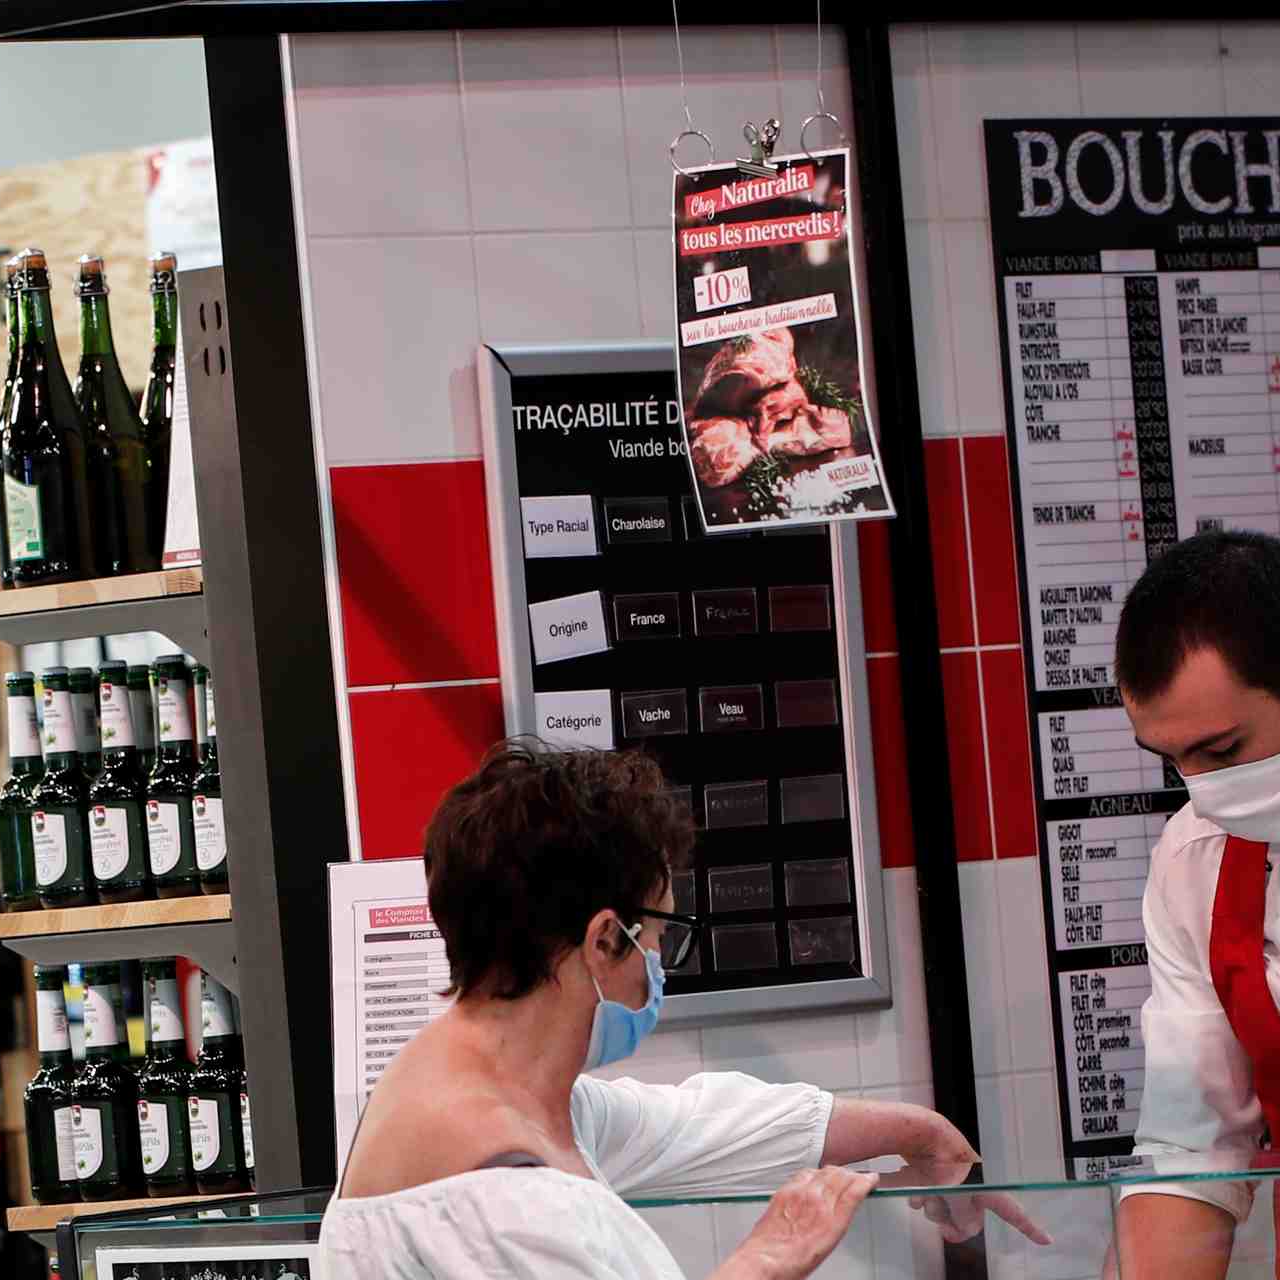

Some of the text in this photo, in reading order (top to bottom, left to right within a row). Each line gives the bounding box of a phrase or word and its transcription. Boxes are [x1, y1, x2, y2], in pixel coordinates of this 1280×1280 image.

[690, 167, 809, 220] Chez Naturalia
[682, 231, 717, 250] tous
[721, 223, 742, 245] les
[1177, 222, 1204, 243] prix
[1208, 224, 1224, 237] au
[1006, 254, 1099, 272] VIANDE BOVINE
[512, 394, 660, 435] TRAÇABILITÉ
[609, 438, 664, 458] Viande
[528, 519, 589, 536] Type Racial
[612, 516, 665, 531] Charolaise
[630, 612, 665, 626] France
[549, 619, 588, 638] Origine
[1091, 687, 1121, 705] VEA
[639, 708, 671, 722] Vache
[719, 702, 744, 716] Veau
[546, 714, 601, 730] Catégorie
[1049, 716, 1065, 734] FILET
[1051, 737, 1069, 753] NOIX
[1089, 794, 1152, 817] AGNEAU
[1058, 824, 1081, 841] GIGOT
[1059, 844, 1082, 862] GIGOT
[1061, 865, 1079, 882] SELLE
[1063, 886, 1079, 903] FILET
[1064, 905, 1102, 924] FAUX-FILET
[1065, 925, 1102, 943] CÔTE FILET
[1070, 974, 1088, 992] FILET
[1072, 994, 1089, 1011] FILET
[1073, 1013, 1093, 1032] CÔTE
[1075, 1034, 1095, 1052] CÔTE
[1082, 1115, 1118, 1135] GRILLADE
